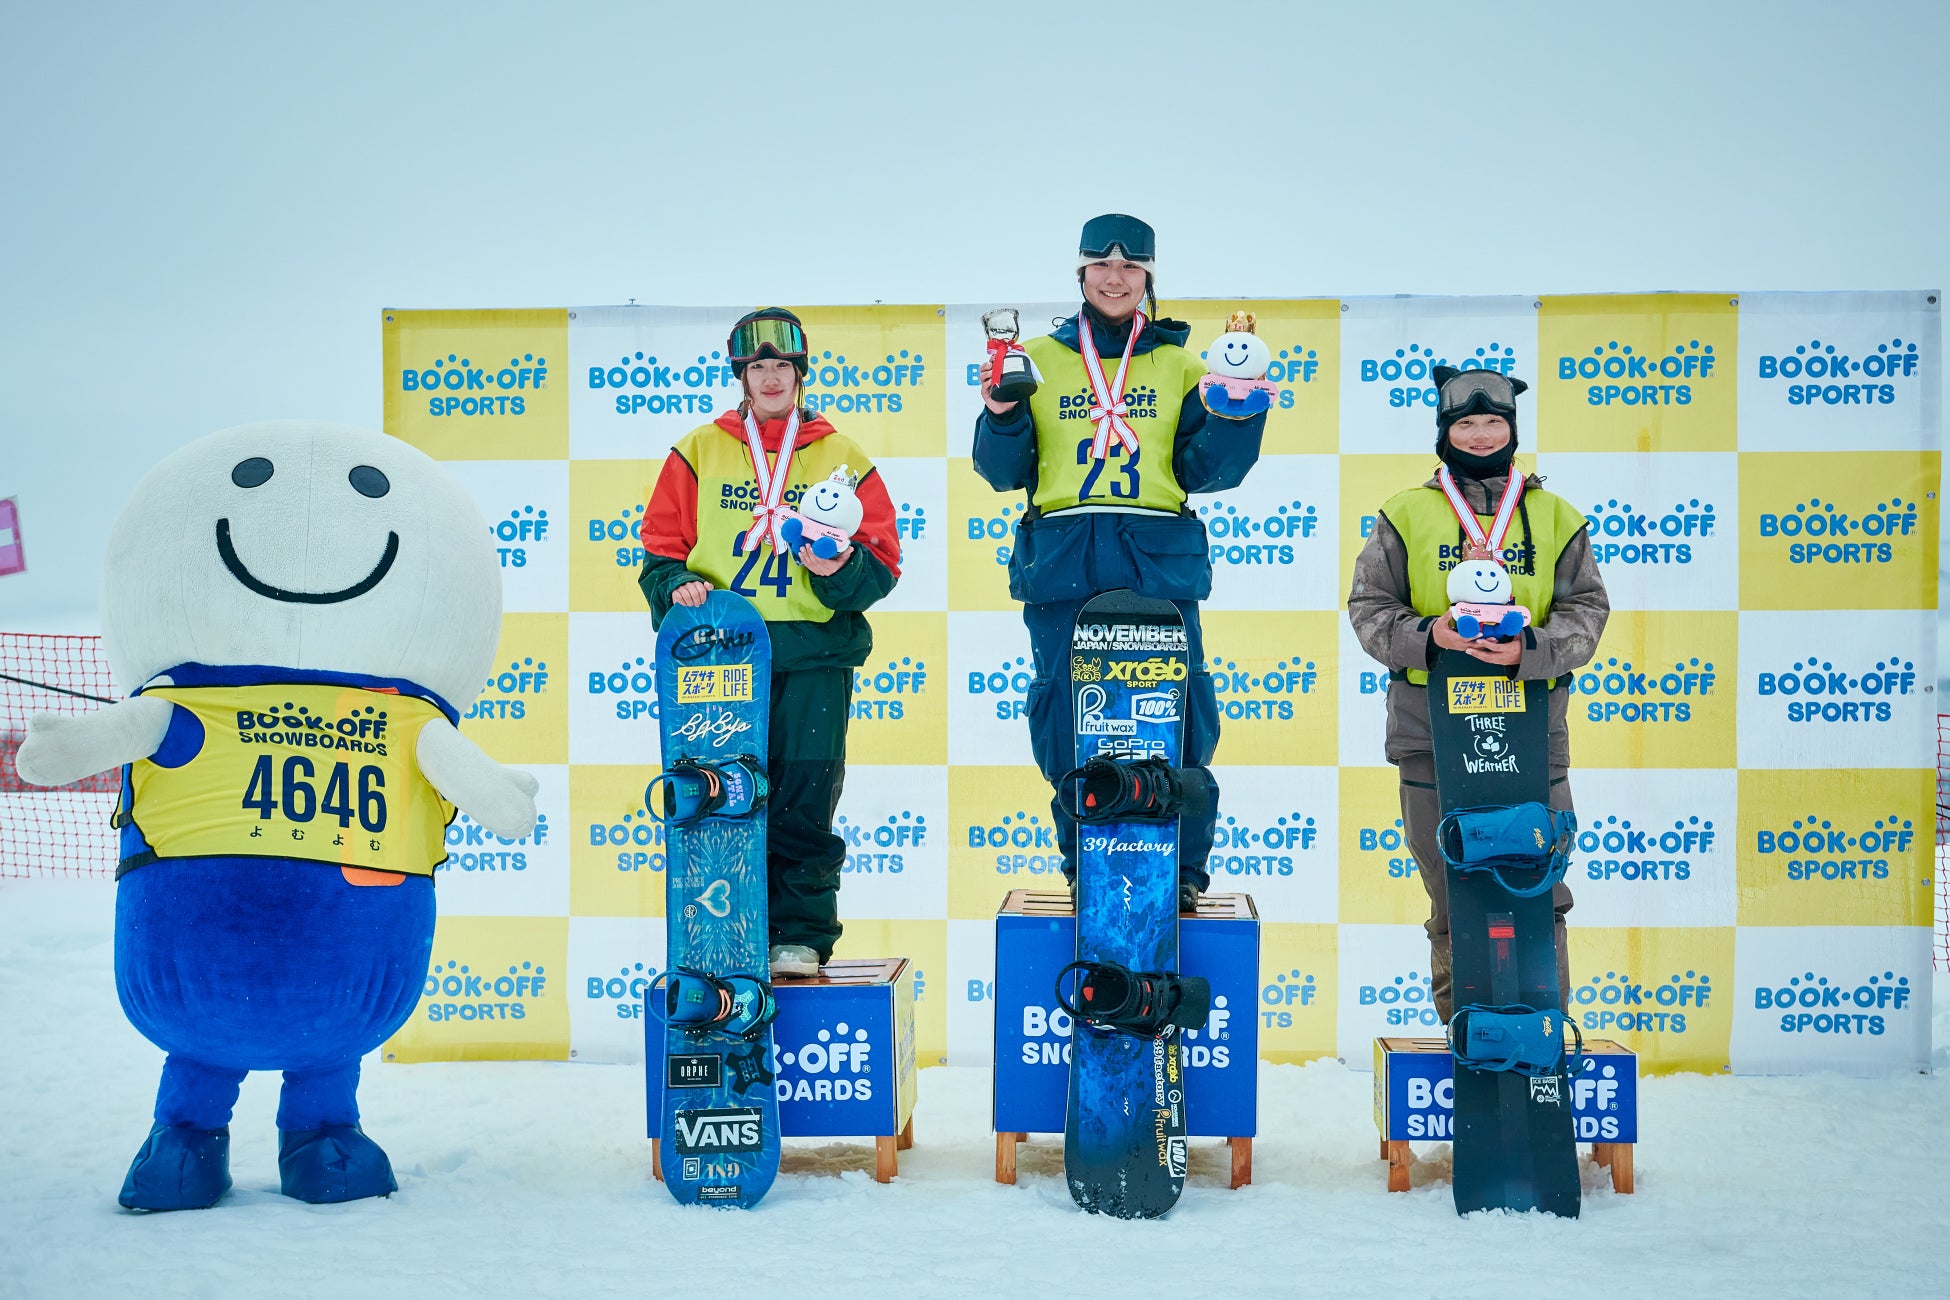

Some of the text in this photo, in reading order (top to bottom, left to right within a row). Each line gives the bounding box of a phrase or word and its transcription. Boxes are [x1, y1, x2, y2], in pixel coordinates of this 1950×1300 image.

[616, 394, 714, 415] SPORTS
[804, 393, 903, 414] SPORTS
[1389, 387, 1439, 408] SPO
[1587, 384, 1692, 406] SPORTS
[1788, 383, 1895, 406] SPORTS
[429, 396, 525, 417] SPORTS
[1077, 438, 1141, 502] 23
[1210, 545, 1294, 566] PORTS
[1789, 542, 1892, 564] SPORTS
[730, 530, 793, 598] 24
[1073, 624, 1187, 642] NOVEMBER
[683, 671, 715, 683] ムラサキ
[723, 668, 748, 683] RIDE
[682, 682, 715, 695] スポーツ
[723, 682, 748, 697] LIFE
[1453, 681, 1486, 693] ムラサキ
[1494, 680, 1520, 694] RIDE
[1139, 700, 1177, 716] 100%
[1453, 693, 1486, 706] スポーツ
[1495, 694, 1521, 708] LIFE
[1587, 701, 1691, 723] SPORTS
[1787, 701, 1891, 723] SPORTS
[1464, 714, 1507, 732] THREE
[238, 731, 388, 757] SNOWBOARDS
[1098, 738, 1165, 749] GoPro
[1462, 753, 1520, 774] WEATHER
[241, 754, 388, 833] 4646
[1573, 830, 1715, 854] OOK·OFF
[617, 852, 667, 872] SPO
[841, 853, 904, 874] ORTS
[996, 855, 1064, 875] SPOR
[1208, 855, 1294, 876] PORTS
[1587, 859, 1691, 881] SPORTS
[1787, 859, 1889, 881] SPORTS
[1568, 984, 1712, 1008] OOK·OFF
[428, 1002, 526, 1022] SPORTS
[1386, 1007, 1439, 1026] SPO
[1583, 1011, 1687, 1034] SPORTS
[1780, 1013, 1885, 1036] SPORTS
[680, 1065, 708, 1077] ORPHE
[777, 1079, 872, 1101] OARDS
[678, 1114, 761, 1147] VANS
[702, 1185, 737, 1193] beyond
